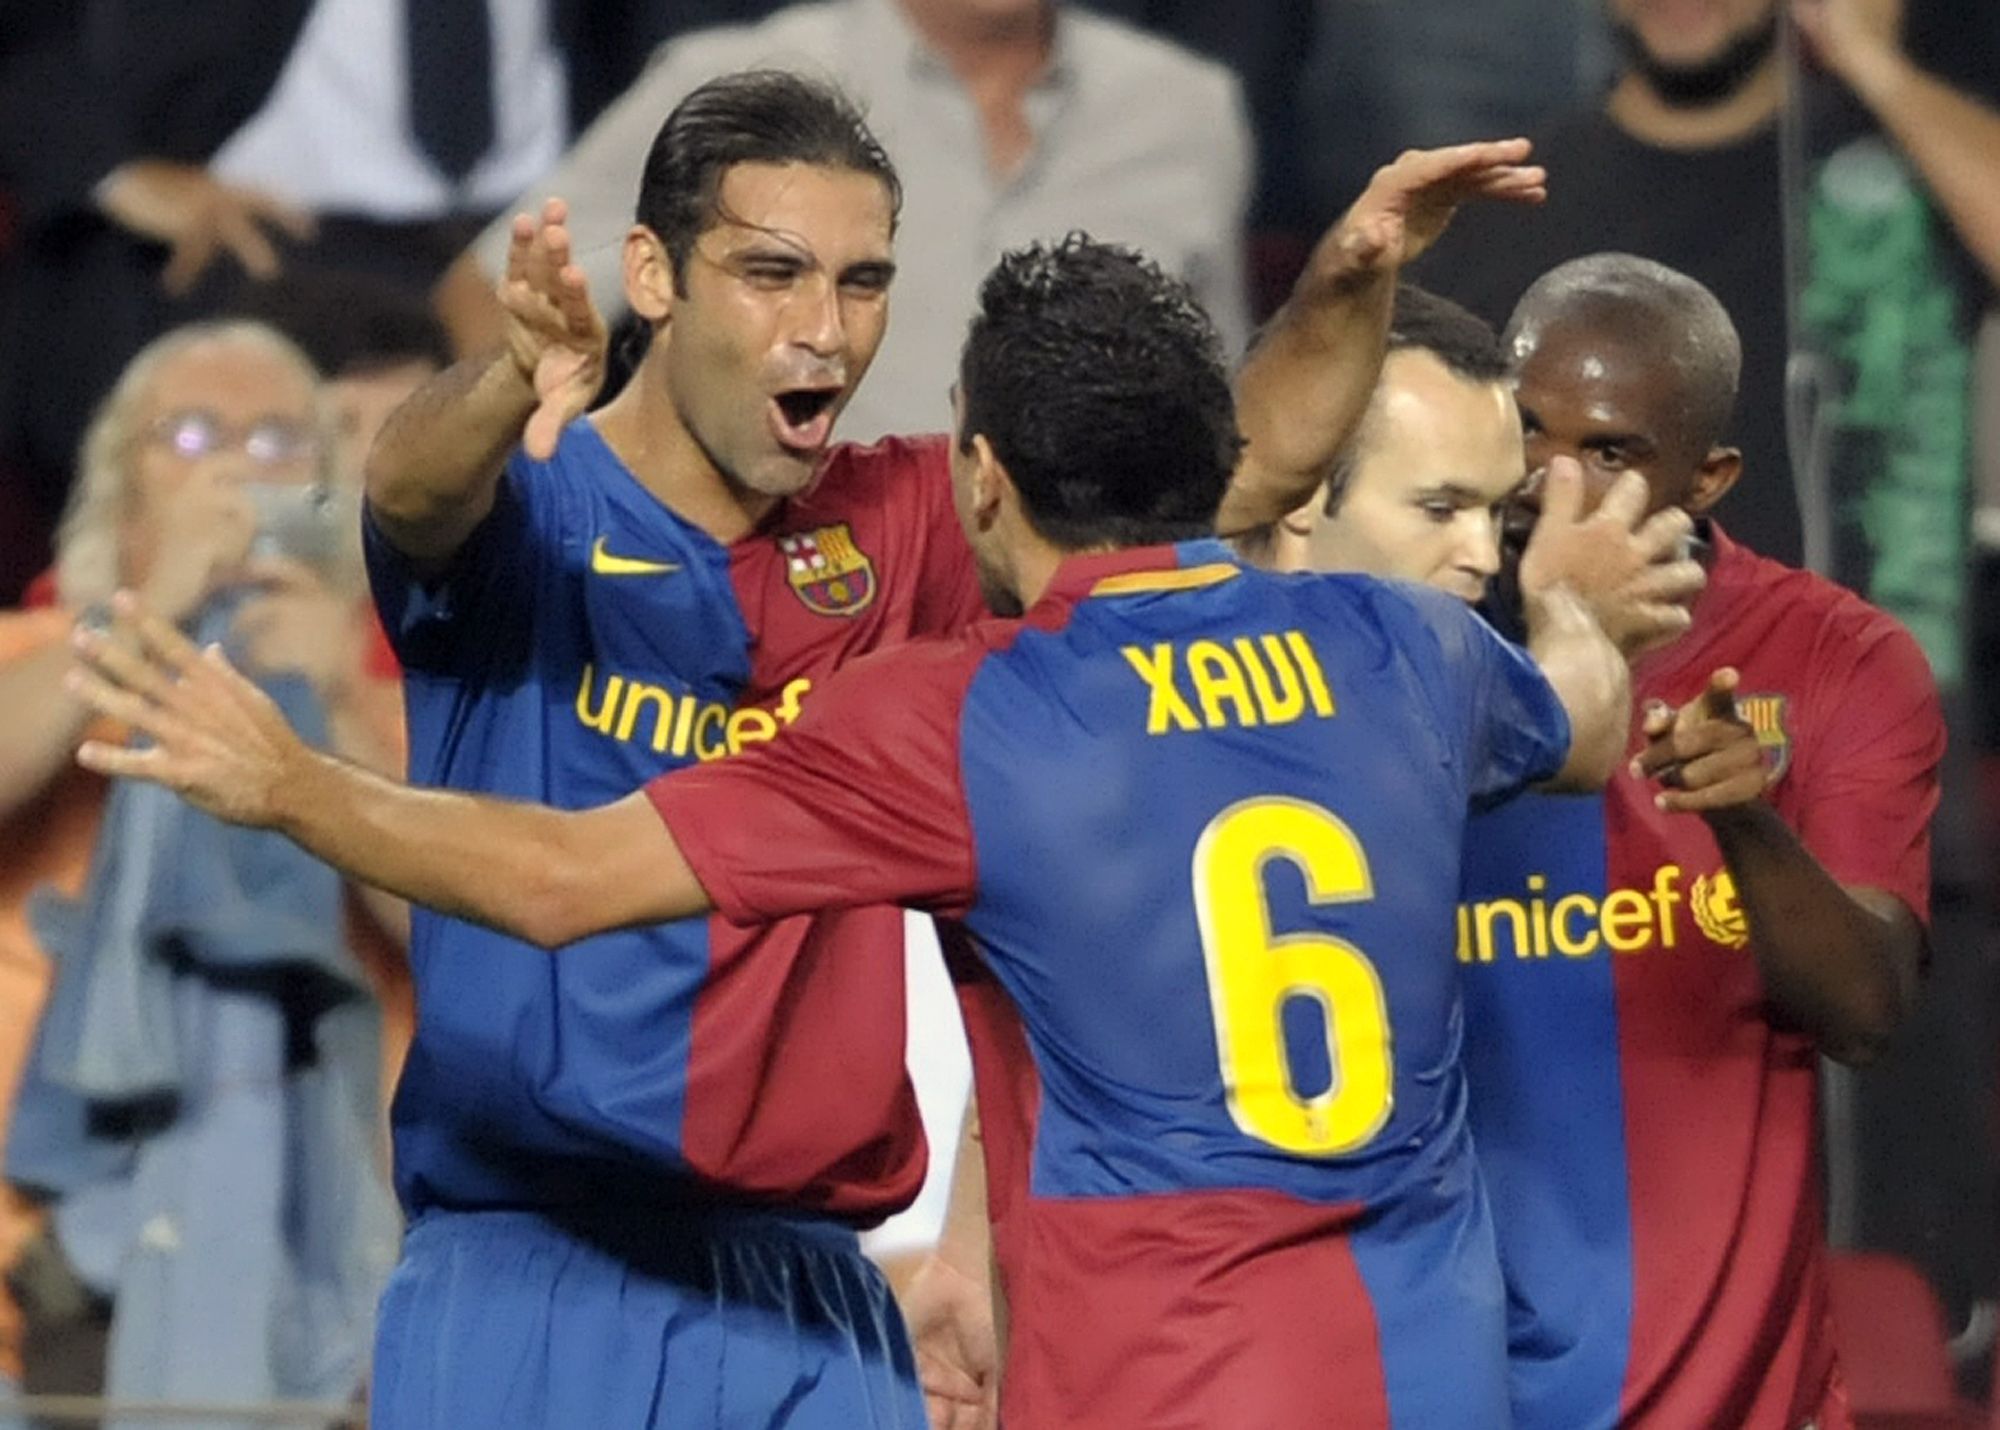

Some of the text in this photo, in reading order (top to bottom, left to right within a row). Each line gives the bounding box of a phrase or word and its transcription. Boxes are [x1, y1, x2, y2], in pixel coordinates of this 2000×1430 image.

[575, 662, 812, 761] unicef
[1119, 629, 1336, 735] XAVI
[1191, 795, 1394, 1156] 6
